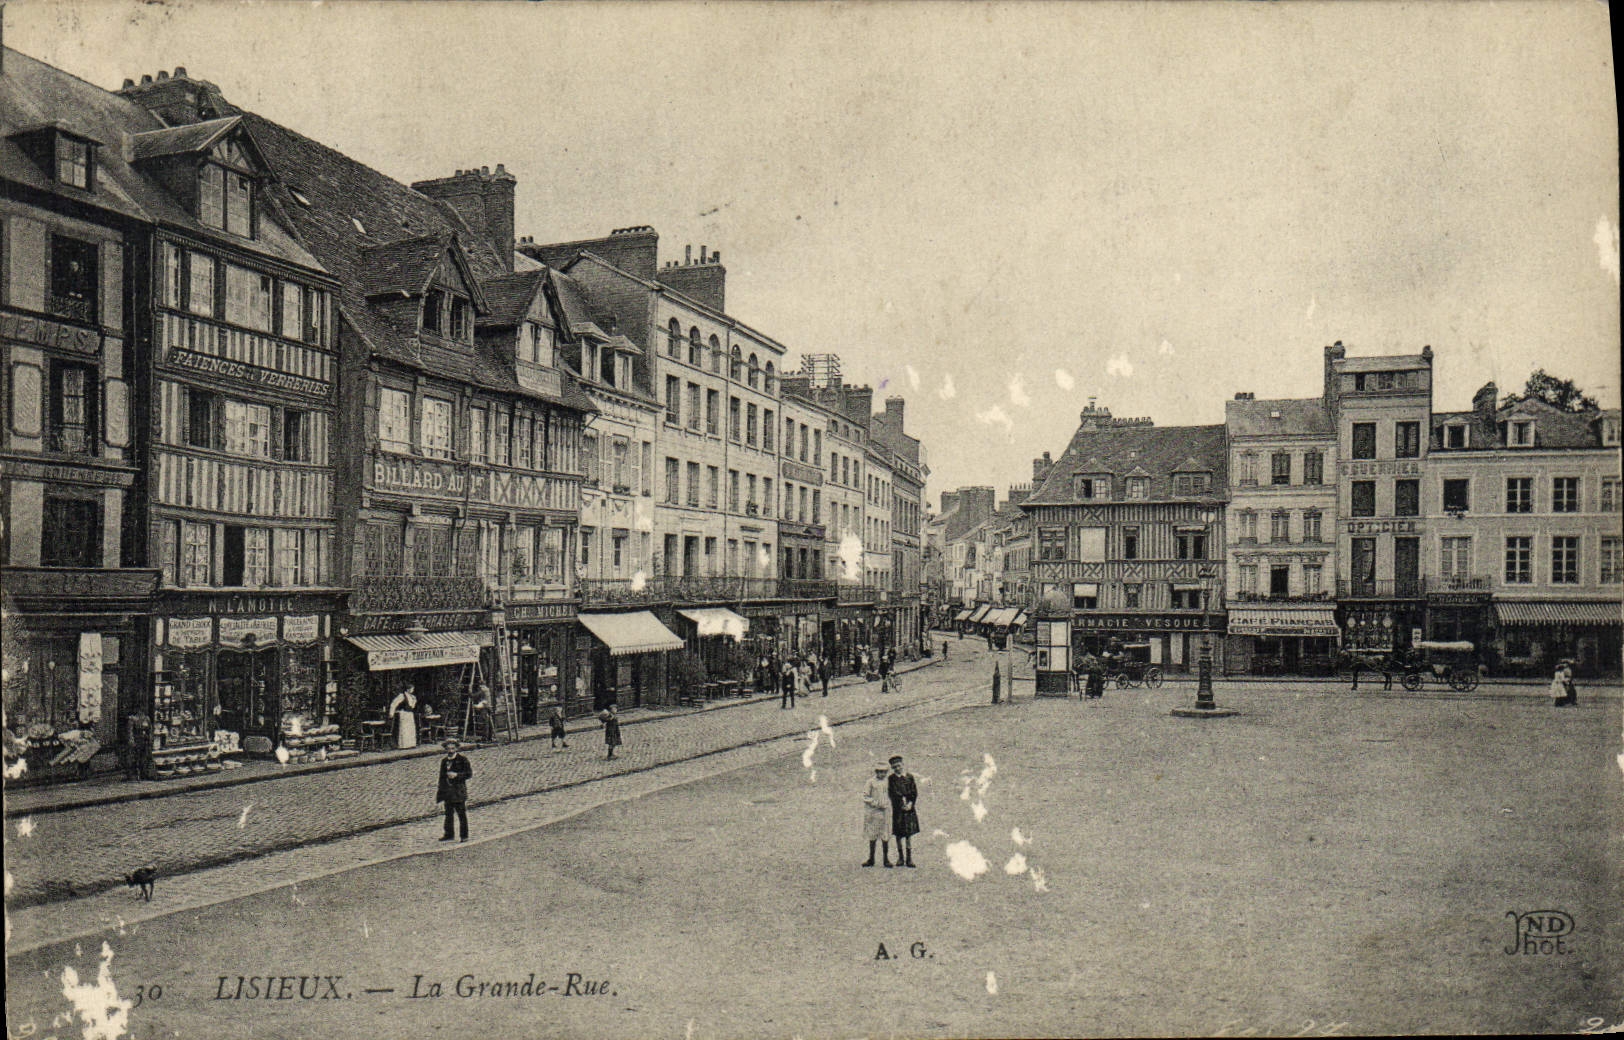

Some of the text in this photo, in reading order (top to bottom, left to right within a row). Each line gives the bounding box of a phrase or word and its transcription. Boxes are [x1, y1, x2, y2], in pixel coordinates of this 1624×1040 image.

[173, 351, 245, 378] FAIENCES
[259, 369, 330, 396] VERRERIES
[374, 463, 443, 490] BILLARD
[447, 472, 465, 493] AU
[1347, 520, 1416, 534] OPTICIEN
[537, 605, 574, 618] MICHEL
[1145, 618, 1199, 628] VESQUE
